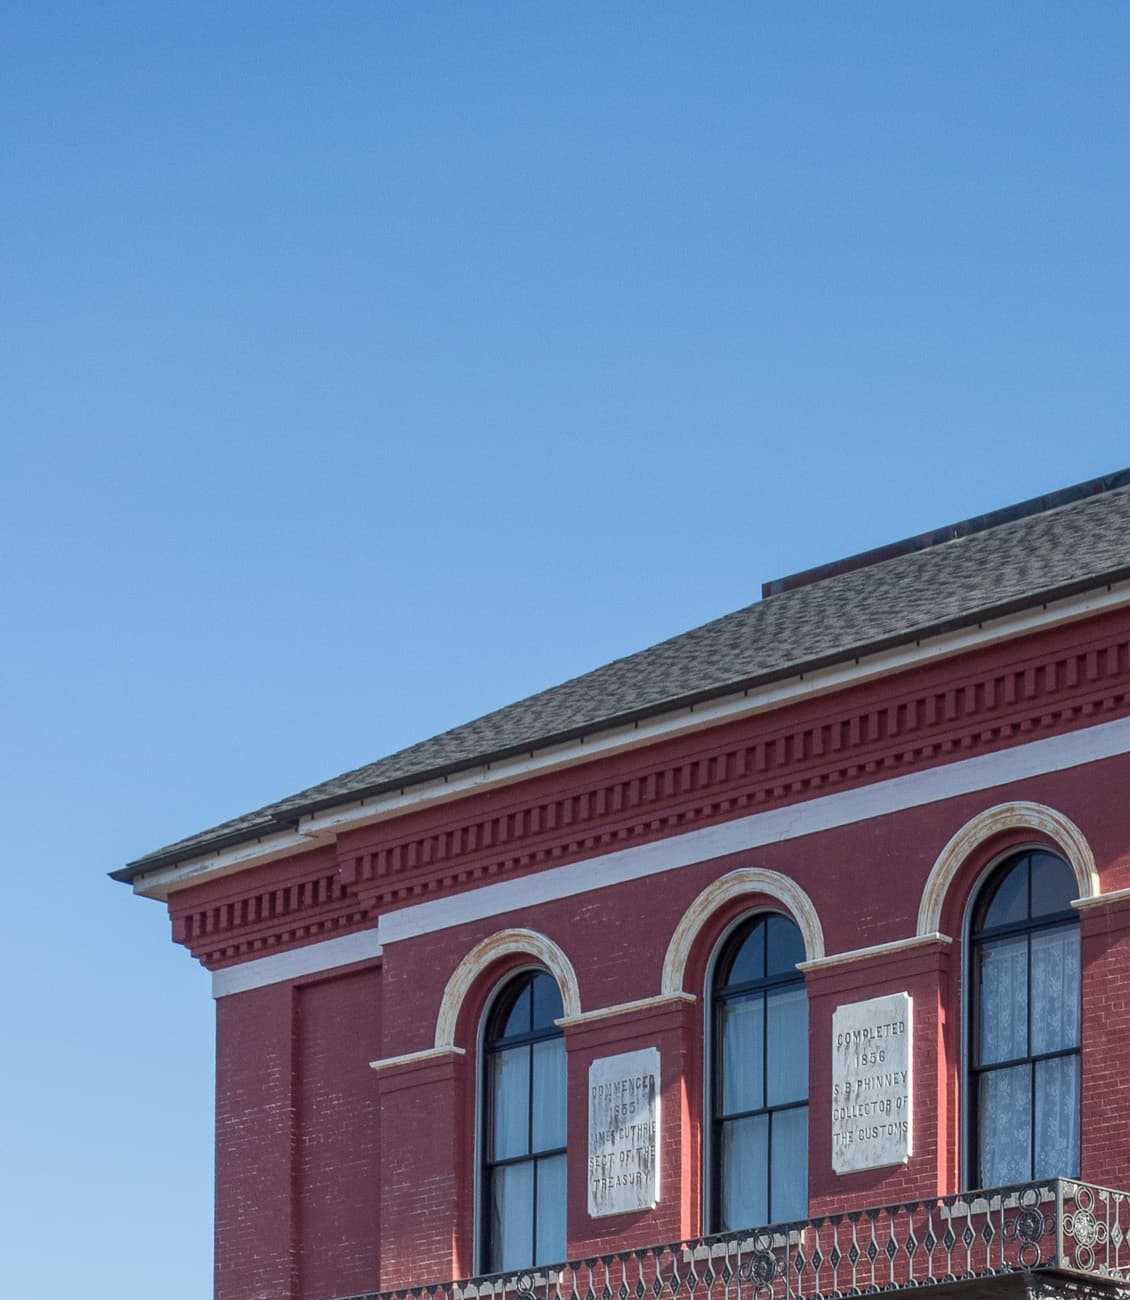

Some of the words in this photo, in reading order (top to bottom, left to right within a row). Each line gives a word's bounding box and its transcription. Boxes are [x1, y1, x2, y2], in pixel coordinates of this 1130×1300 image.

[837, 1021, 905, 1046] COMPLETED
[856, 1050, 886, 1067] 1856
[592, 1074, 655, 1099] COMMENCED
[833, 1098, 892, 1121] COLLECTOR
[896, 1096, 908, 1109] OF
[619, 1121, 656, 1140] GUTHRIE
[833, 1131, 854, 1145] THE
[858, 1121, 908, 1141] CUSTOMS
[620, 1149, 632, 1163] OF
[636, 1145, 655, 1160] THE
